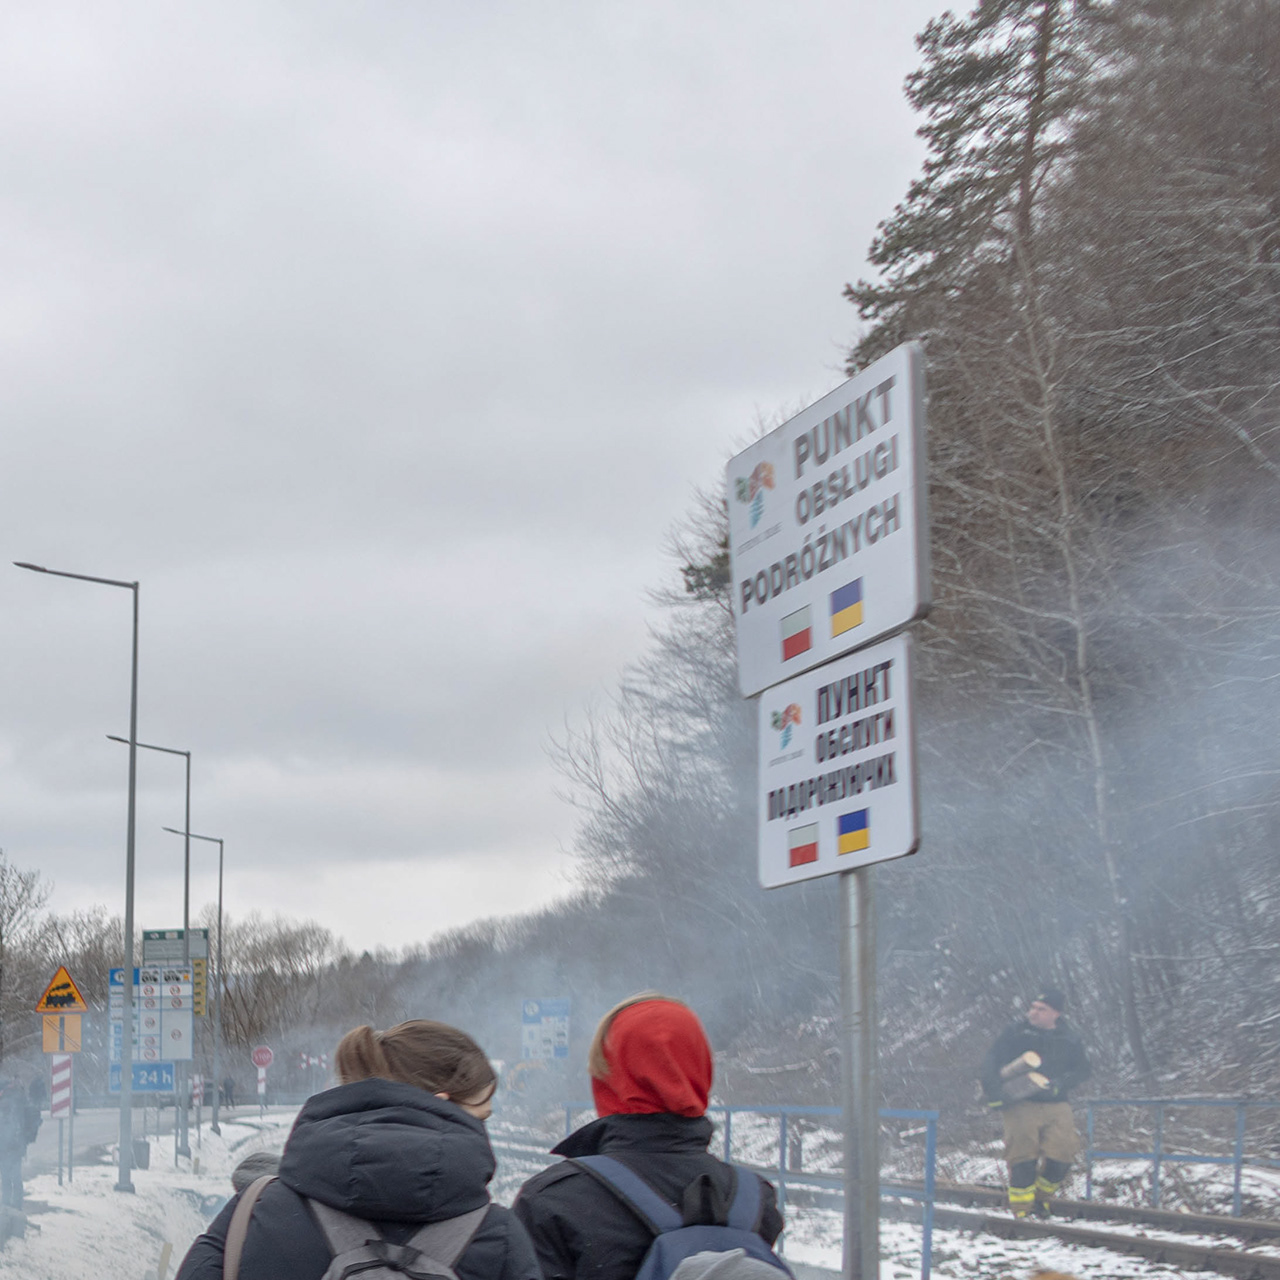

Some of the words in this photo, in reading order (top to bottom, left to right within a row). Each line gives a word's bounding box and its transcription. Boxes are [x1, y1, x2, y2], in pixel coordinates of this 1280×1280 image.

[792, 374, 897, 481] PUNKT
[795, 433, 899, 526] OBSŁUGI
[739, 492, 901, 615] PODRÓŻNYCH
[817, 658, 895, 726] ПУНКТ
[816, 707, 896, 764] ОБСЛУГИ
[139, 1070, 158, 1085] 24
